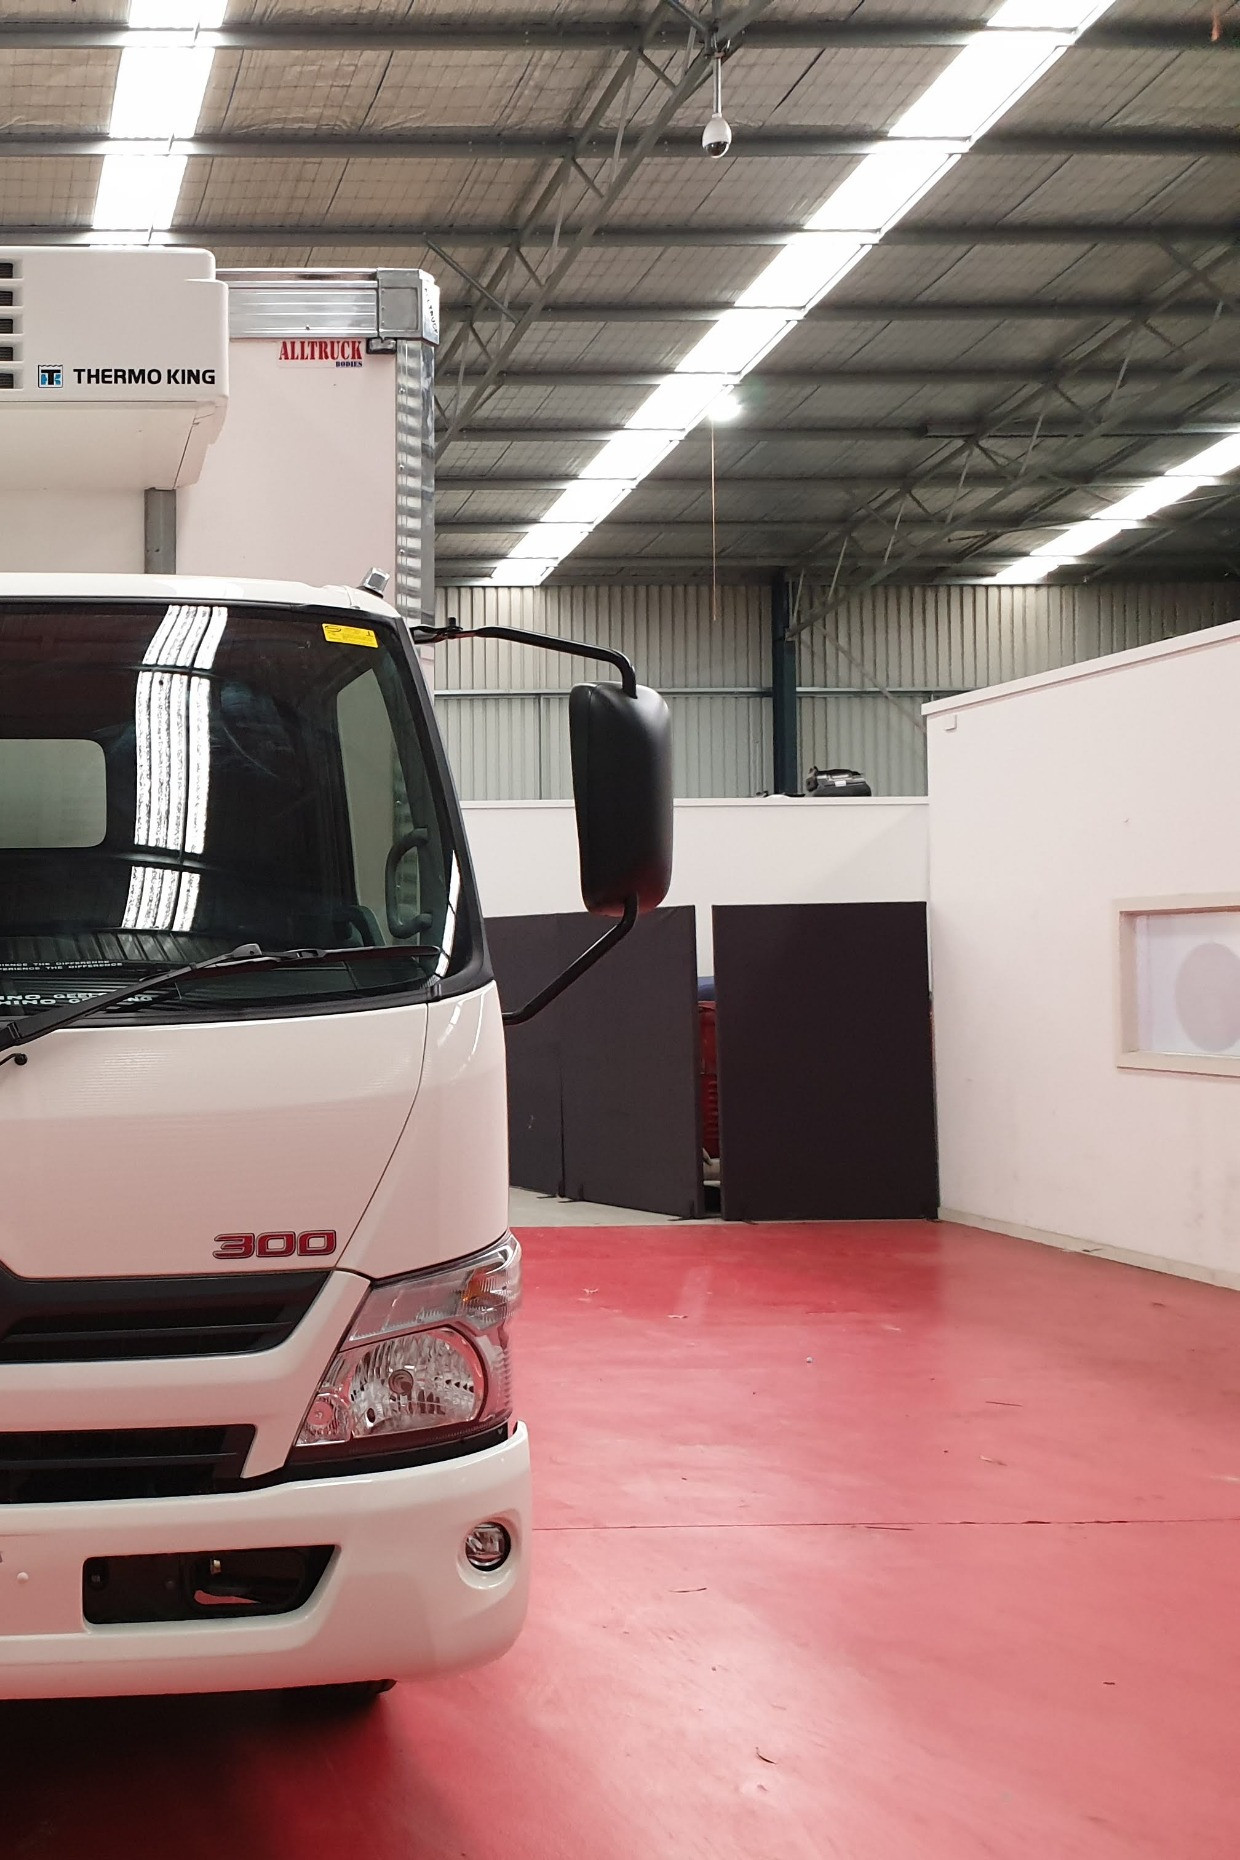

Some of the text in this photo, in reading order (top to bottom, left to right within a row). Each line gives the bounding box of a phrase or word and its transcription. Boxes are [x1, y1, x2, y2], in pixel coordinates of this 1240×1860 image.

[279, 340, 362, 360] ALLTRUCK
[73, 368, 216, 385] THERMO KING
[212, 1230, 336, 1259] 300
